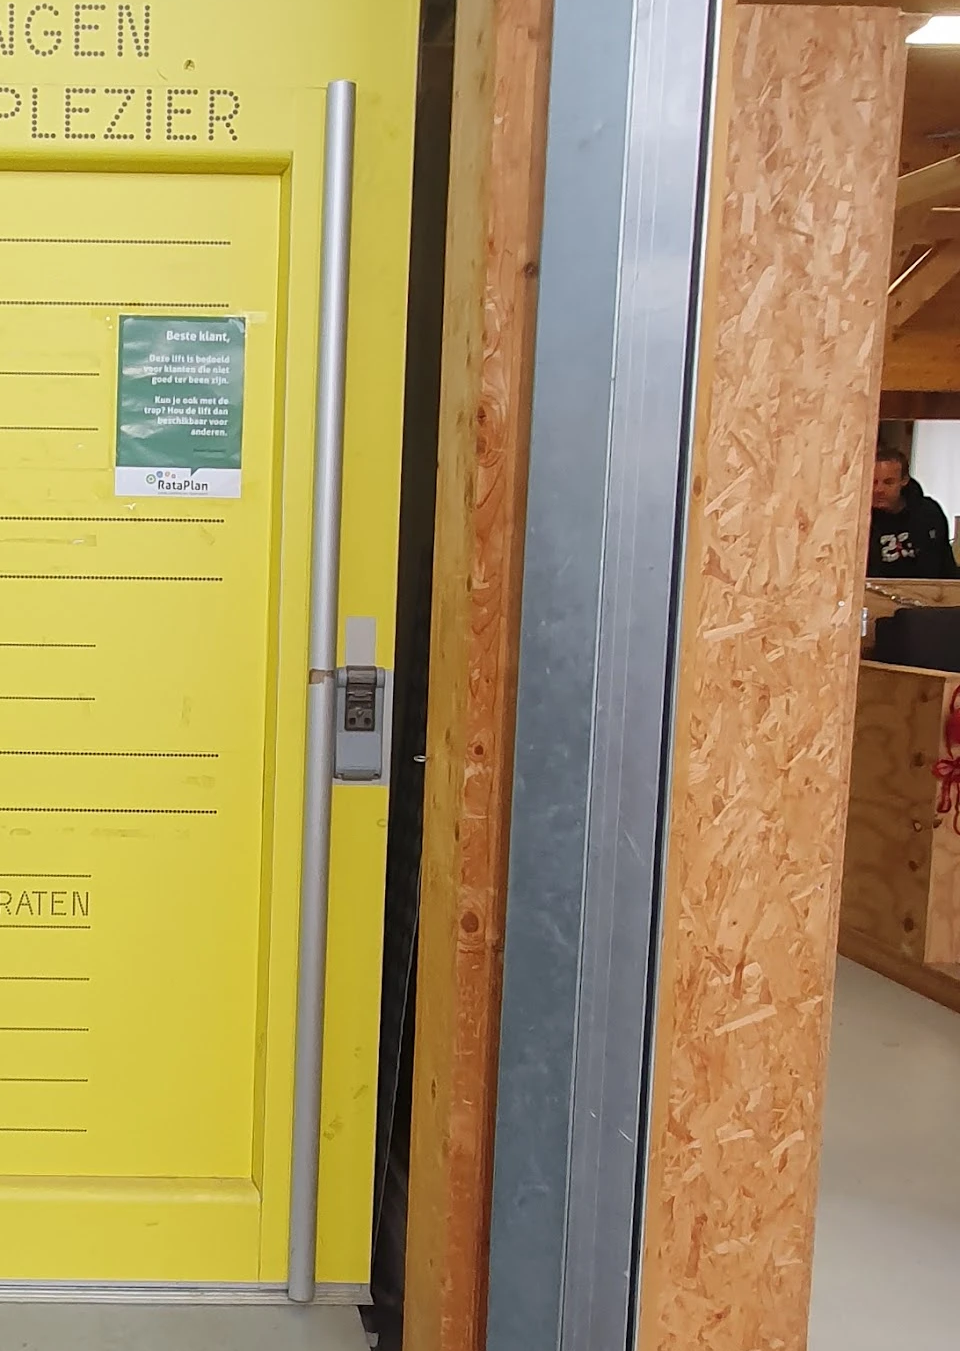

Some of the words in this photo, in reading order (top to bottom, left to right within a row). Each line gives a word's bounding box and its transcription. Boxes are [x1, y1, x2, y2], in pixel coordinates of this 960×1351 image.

[166, 330, 197, 342] Beste
[199, 330, 231, 343] klant,
[149, 353, 170, 364] Deze
[171, 353, 185, 364] lift
[187, 353, 194, 364] is
[195, 354, 230, 364] bedoeld
[143, 365, 162, 374] voor
[163, 364, 196, 375] klanten
[197, 365, 211, 375] die
[212, 365, 230, 375] niet
[152, 375, 173, 386] goed
[174, 376, 187, 385] ter
[188, 375, 210, 385] been
[211, 376, 229, 386] zijn.
[155, 395, 171, 405] Kun
[172, 396, 181, 406] je
[182, 396, 198, 406] ook
[199, 396, 217, 406] met
[218, 396, 230, 406] de
[143, 406, 166, 417] trap?
[167, 406, 184, 416] Hou
[185, 407, 197, 416] de
[197, 407, 211, 416] lift
[213, 407, 229, 416] dan
[157, 416, 208, 426] beschikbaar
[209, 418, 229, 426] voor
[191, 427, 228, 437] anderen.
[158, 479, 209, 491] RataPlan
